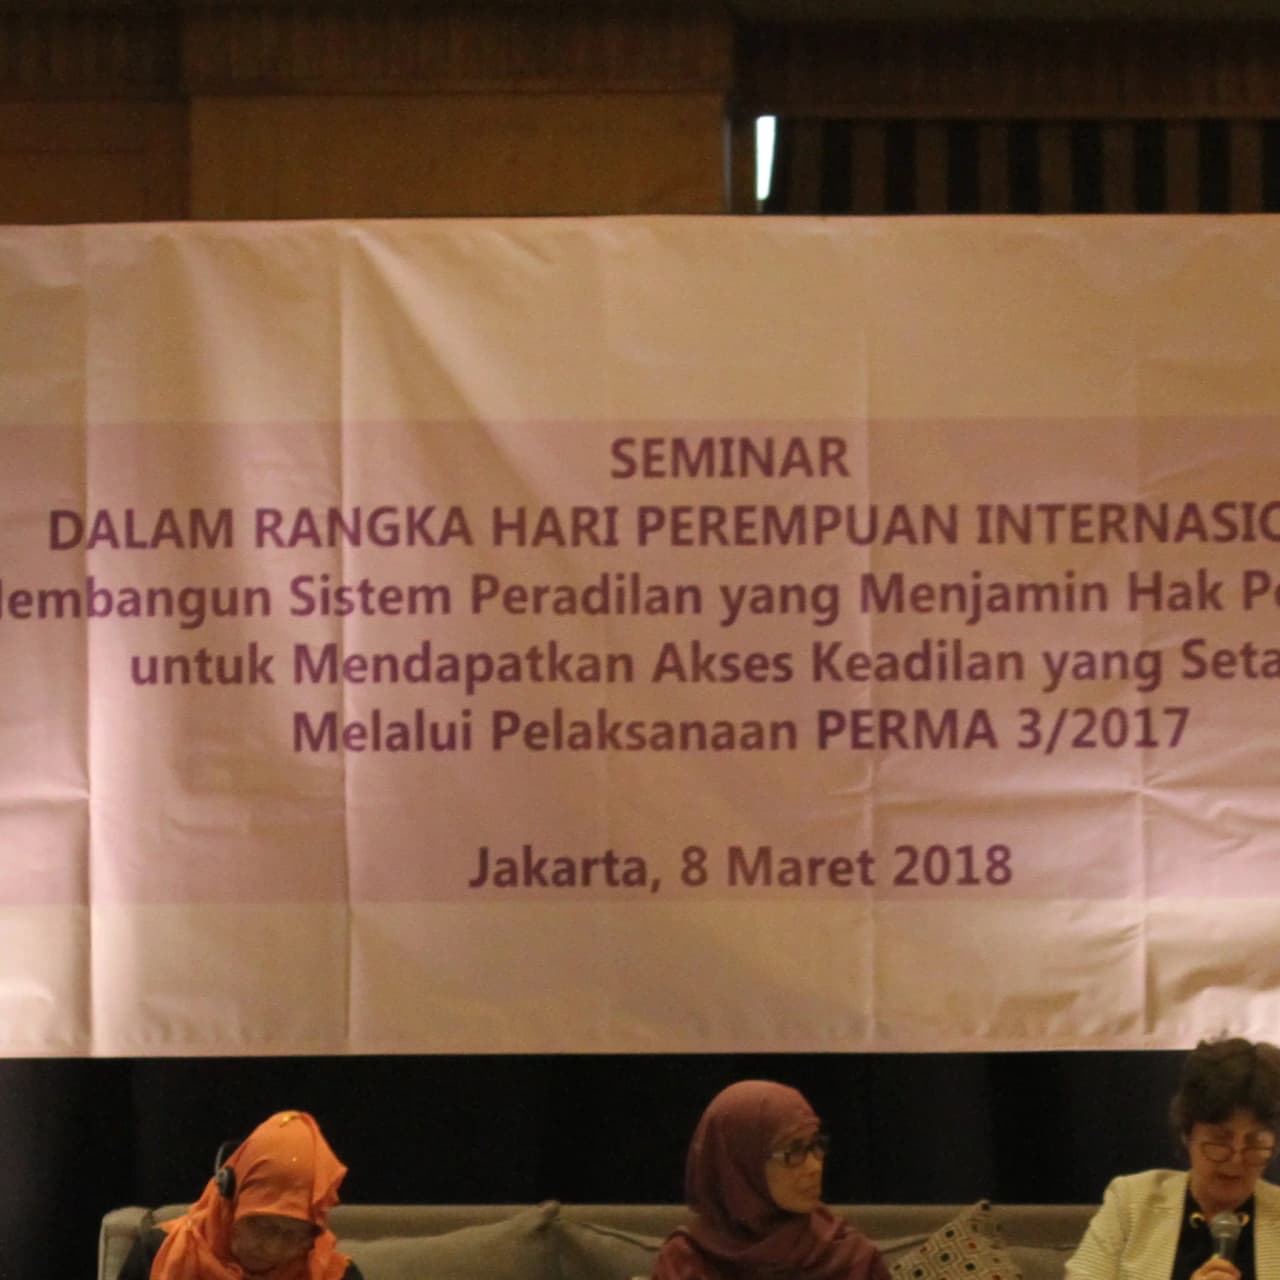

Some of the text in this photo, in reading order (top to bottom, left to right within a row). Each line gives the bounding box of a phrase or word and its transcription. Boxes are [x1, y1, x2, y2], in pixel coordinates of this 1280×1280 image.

[611, 436, 849, 479] SEMINAR
[50, 508, 232, 550] DALAM
[256, 506, 473, 548] RANGKA
[493, 506, 618, 547] HARI
[638, 504, 957, 546] PEREMPUAN
[291, 574, 450, 617] Sistem
[472, 572, 702, 615] Peradilan
[720, 584, 839, 627] yang
[861, 570, 1107, 625] Menjamin
[1129, 568, 1223, 611] Hak
[131, 643, 273, 686] untuk
[295, 640, 633, 695] Mendapatkan
[652, 640, 793, 683] Akses
[813, 639, 1024, 682] Keadilan
[1043, 650, 1162, 693] yang
[294, 707, 1189, 755] Melalui Pelaksanaan PERMA 3/2017
[469, 845, 1012, 893] Jakarta, 8 Maret 2018
